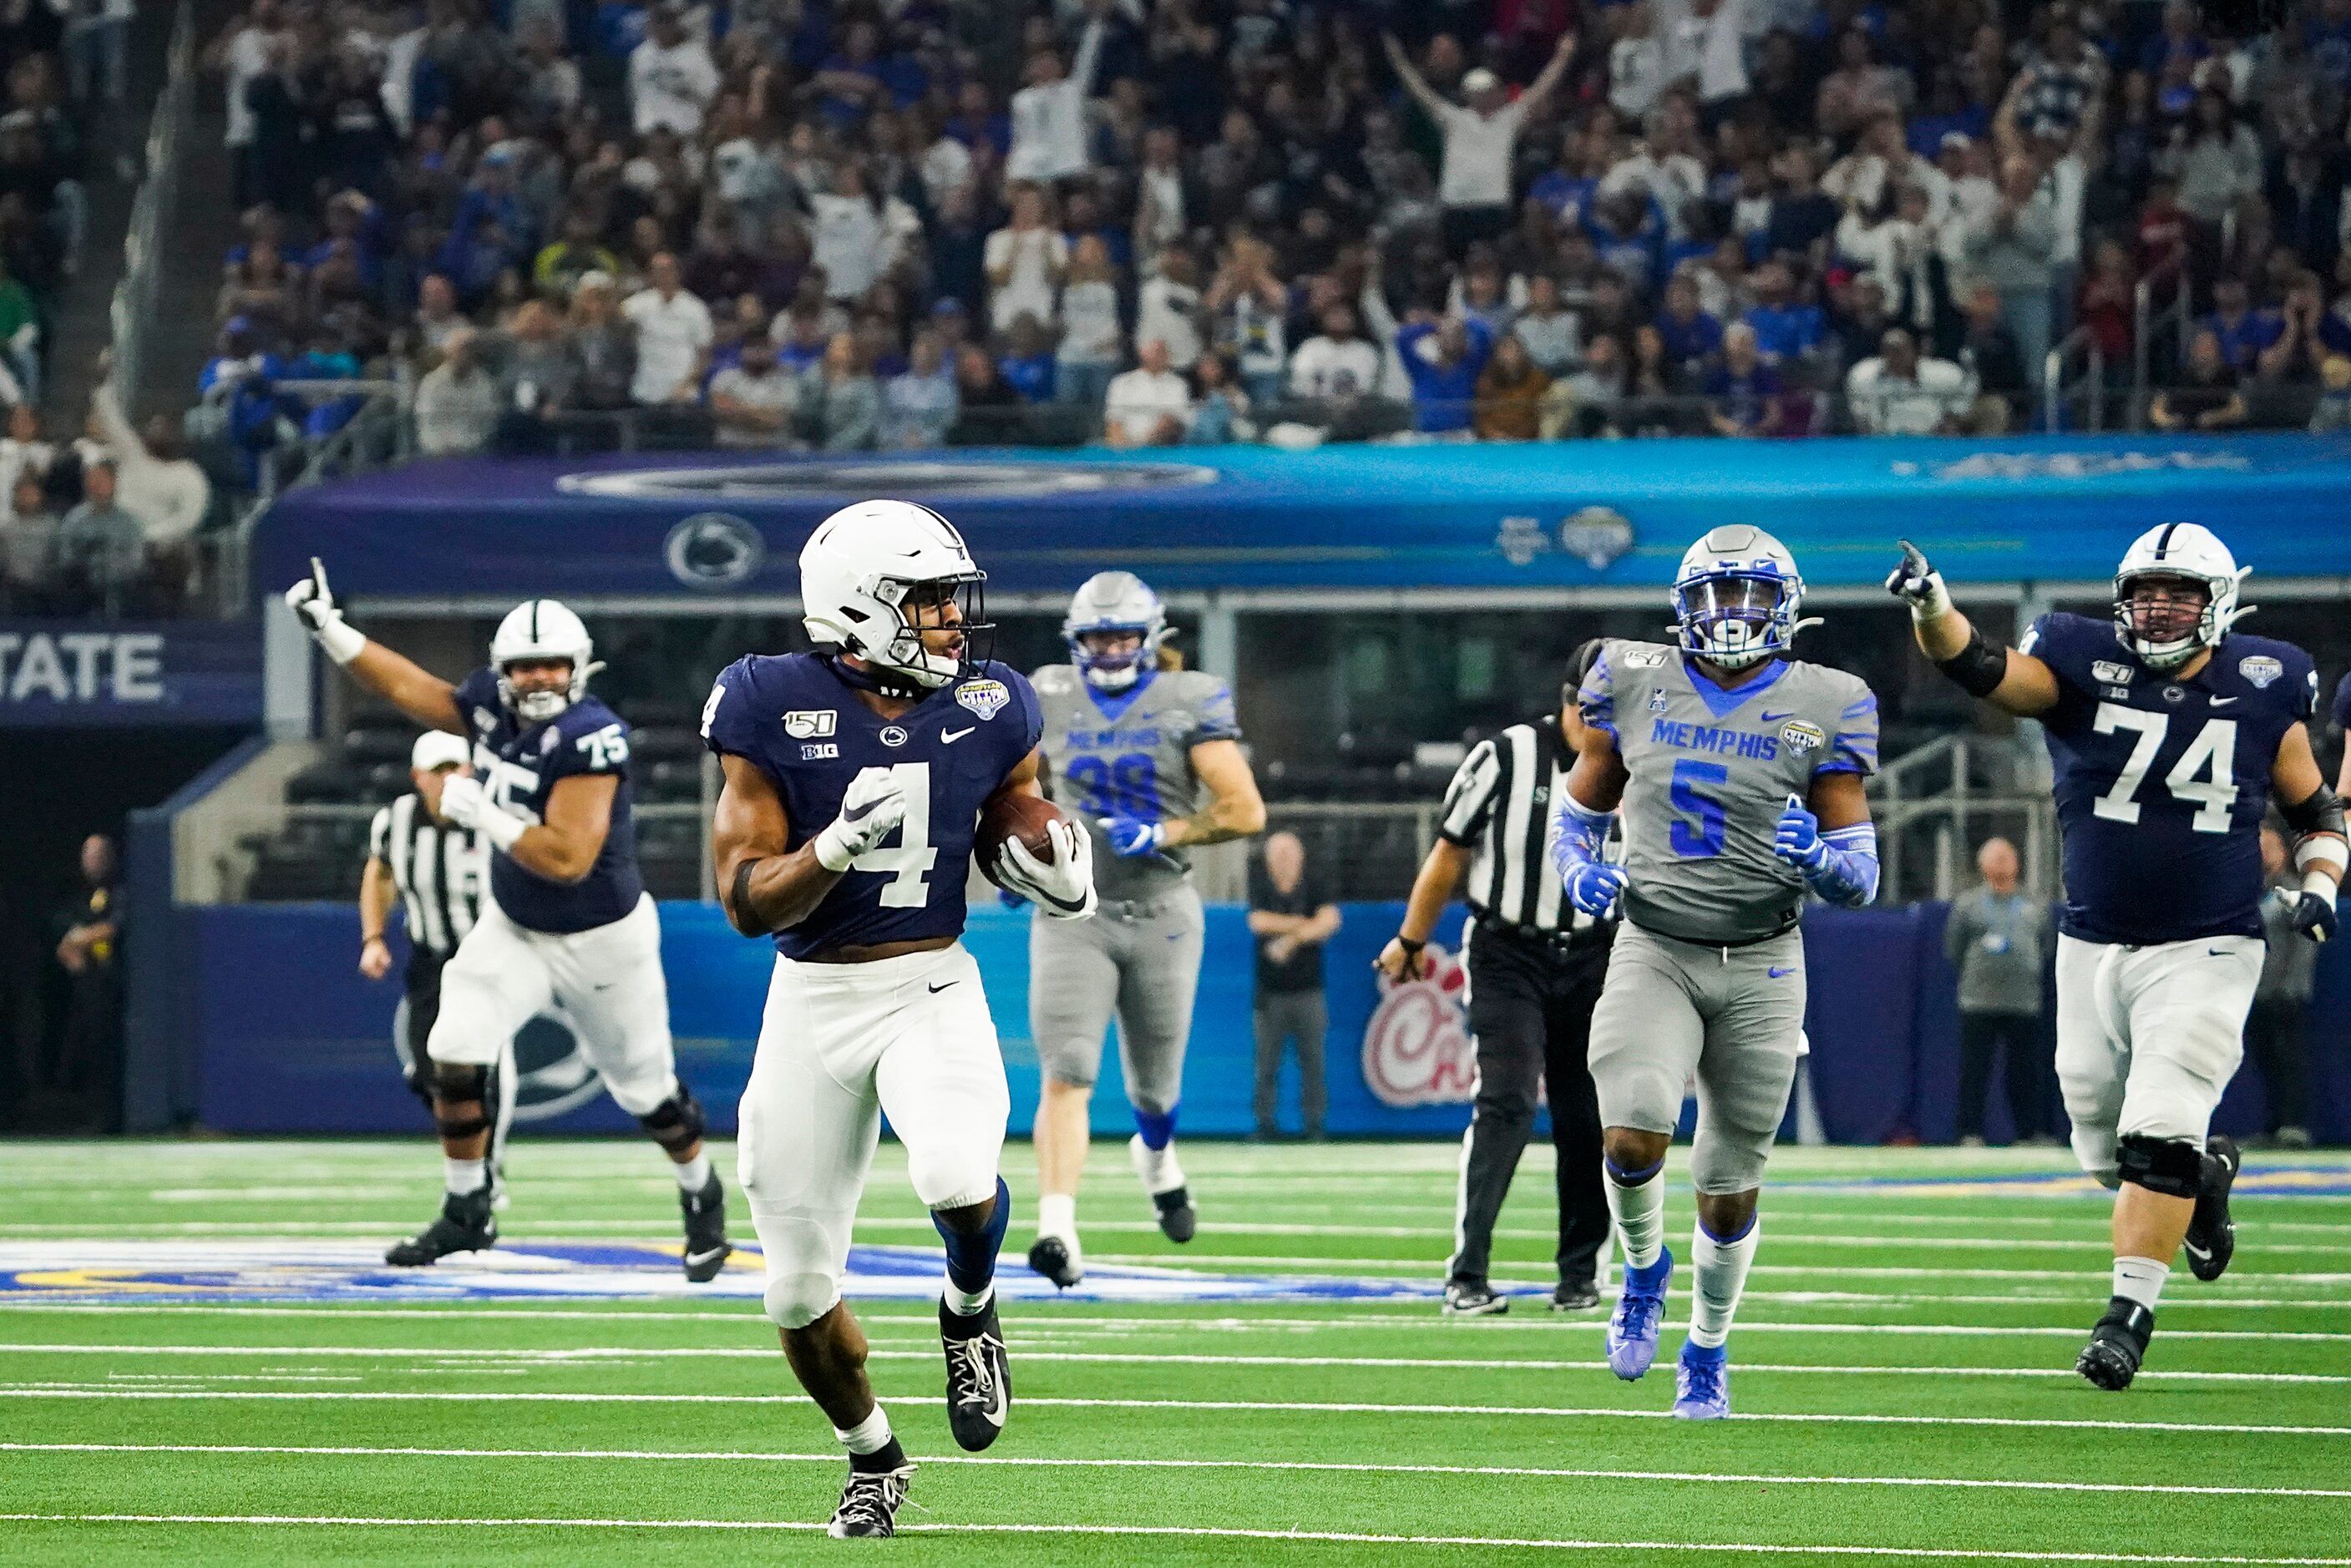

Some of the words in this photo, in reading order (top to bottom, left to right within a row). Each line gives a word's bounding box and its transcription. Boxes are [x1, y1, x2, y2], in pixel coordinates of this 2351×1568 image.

[575, 723, 629, 769] 75
[782, 710, 837, 739] 150
[1650, 717, 1779, 761] MEMPHIS
[2092, 701, 2239, 834] 74
[851, 761, 939, 908] 4
[1670, 758, 1728, 857] 5
